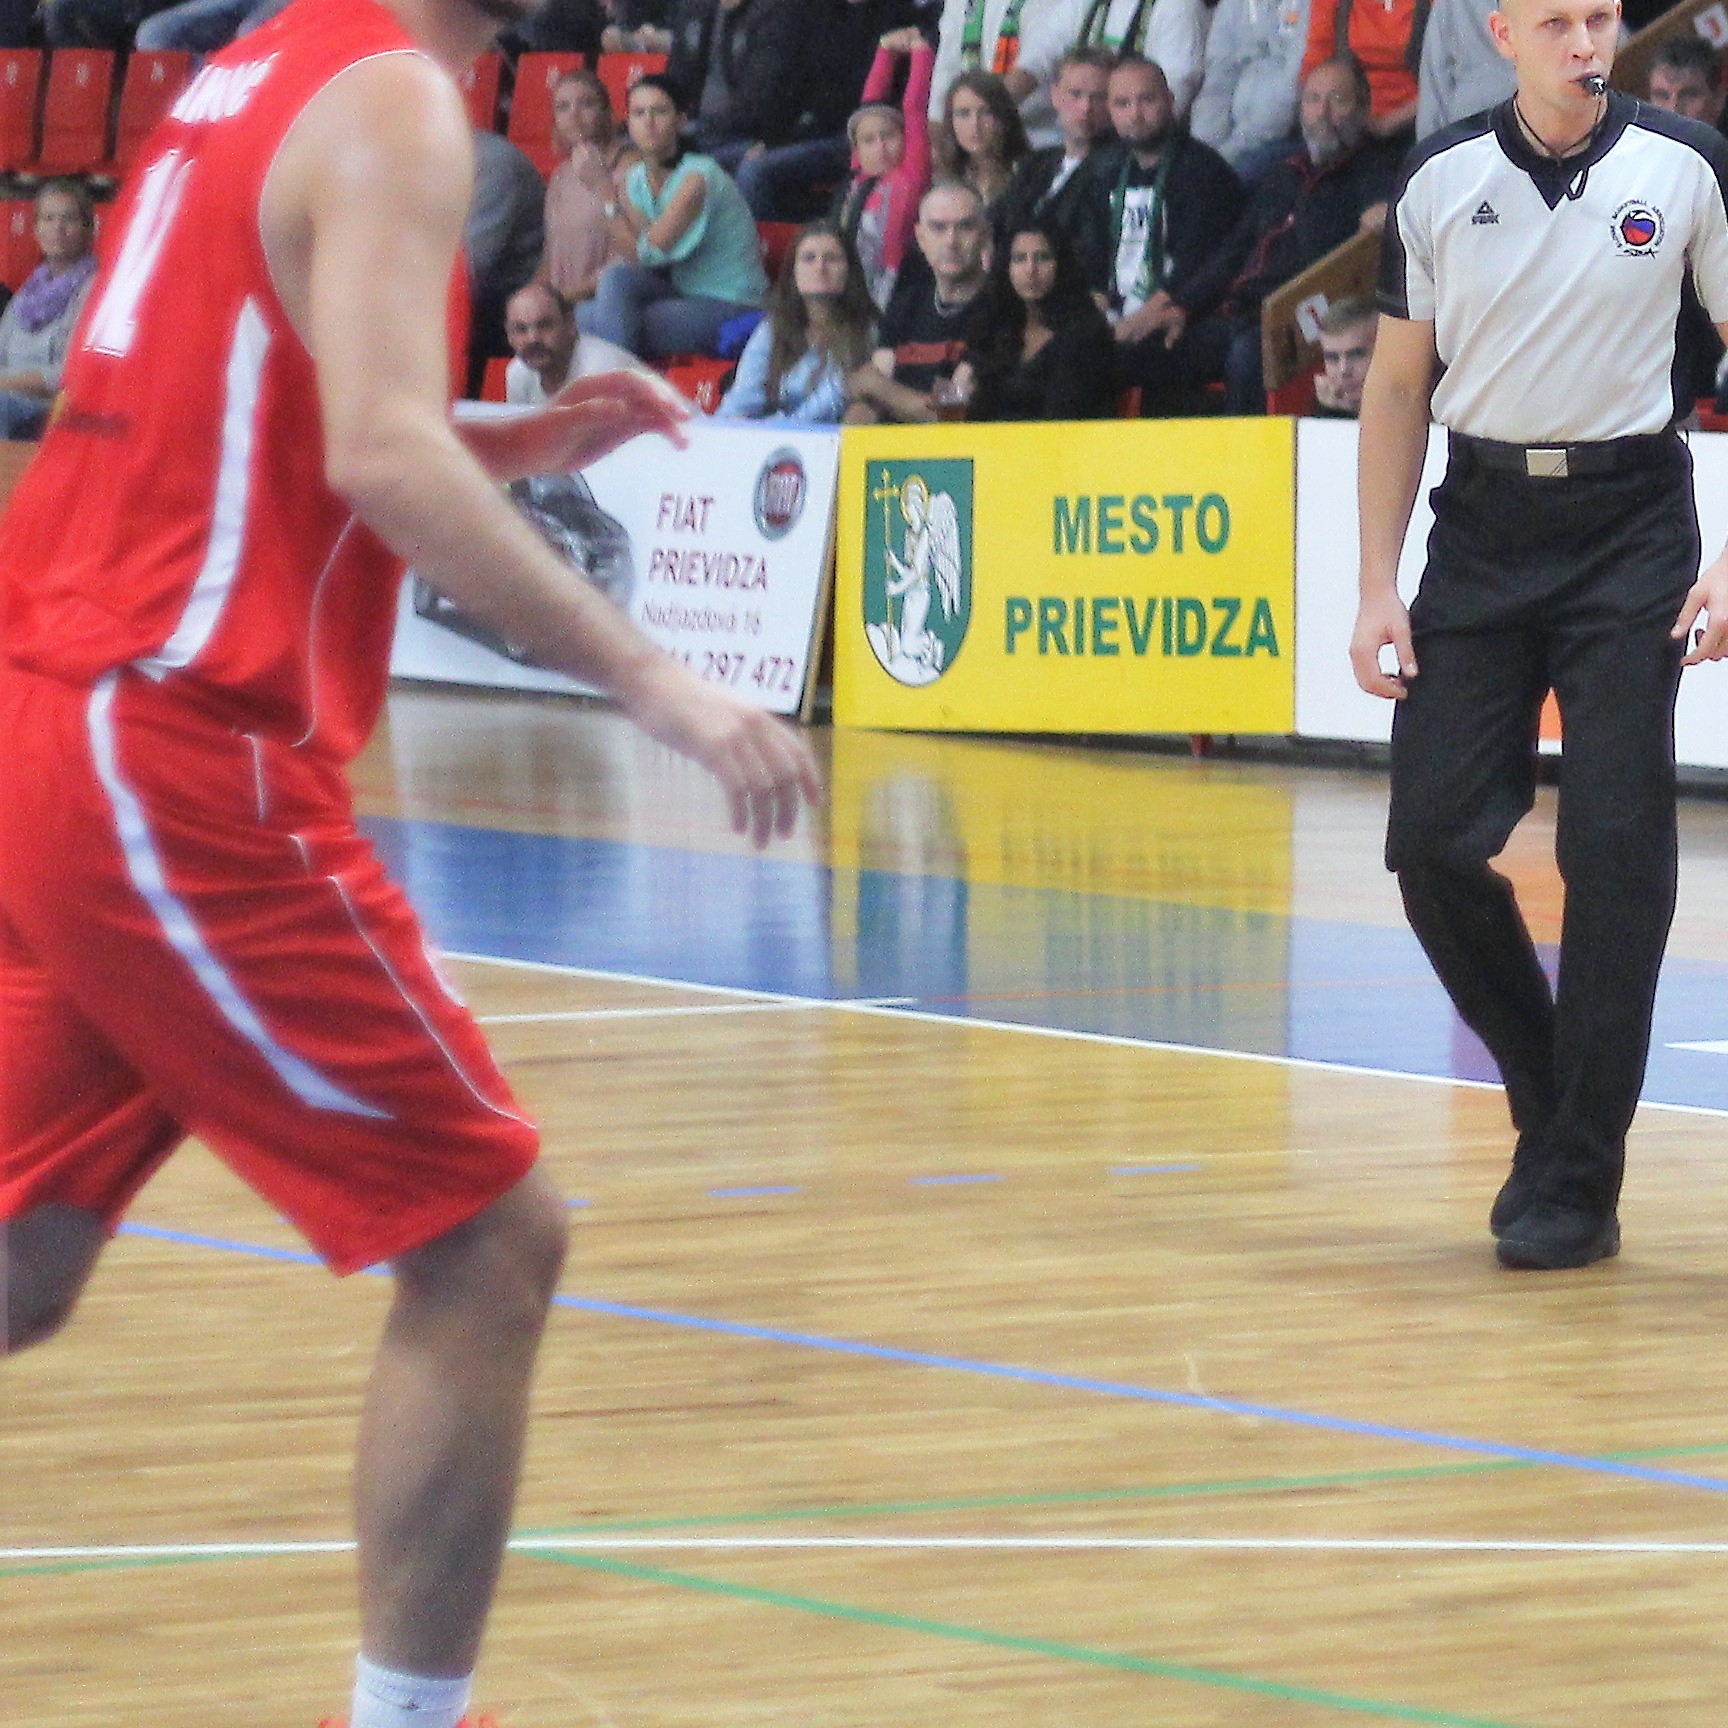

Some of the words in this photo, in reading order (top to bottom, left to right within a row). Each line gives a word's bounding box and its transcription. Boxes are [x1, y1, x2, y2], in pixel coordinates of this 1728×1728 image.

[657, 493, 715, 534] FIAT
[1052, 492, 1231, 556] MESTO
[649, 548, 769, 592] PRIEVIDZA
[1005, 594, 1281, 659] PRIEVIDZA
[753, 655, 797, 693] 472
